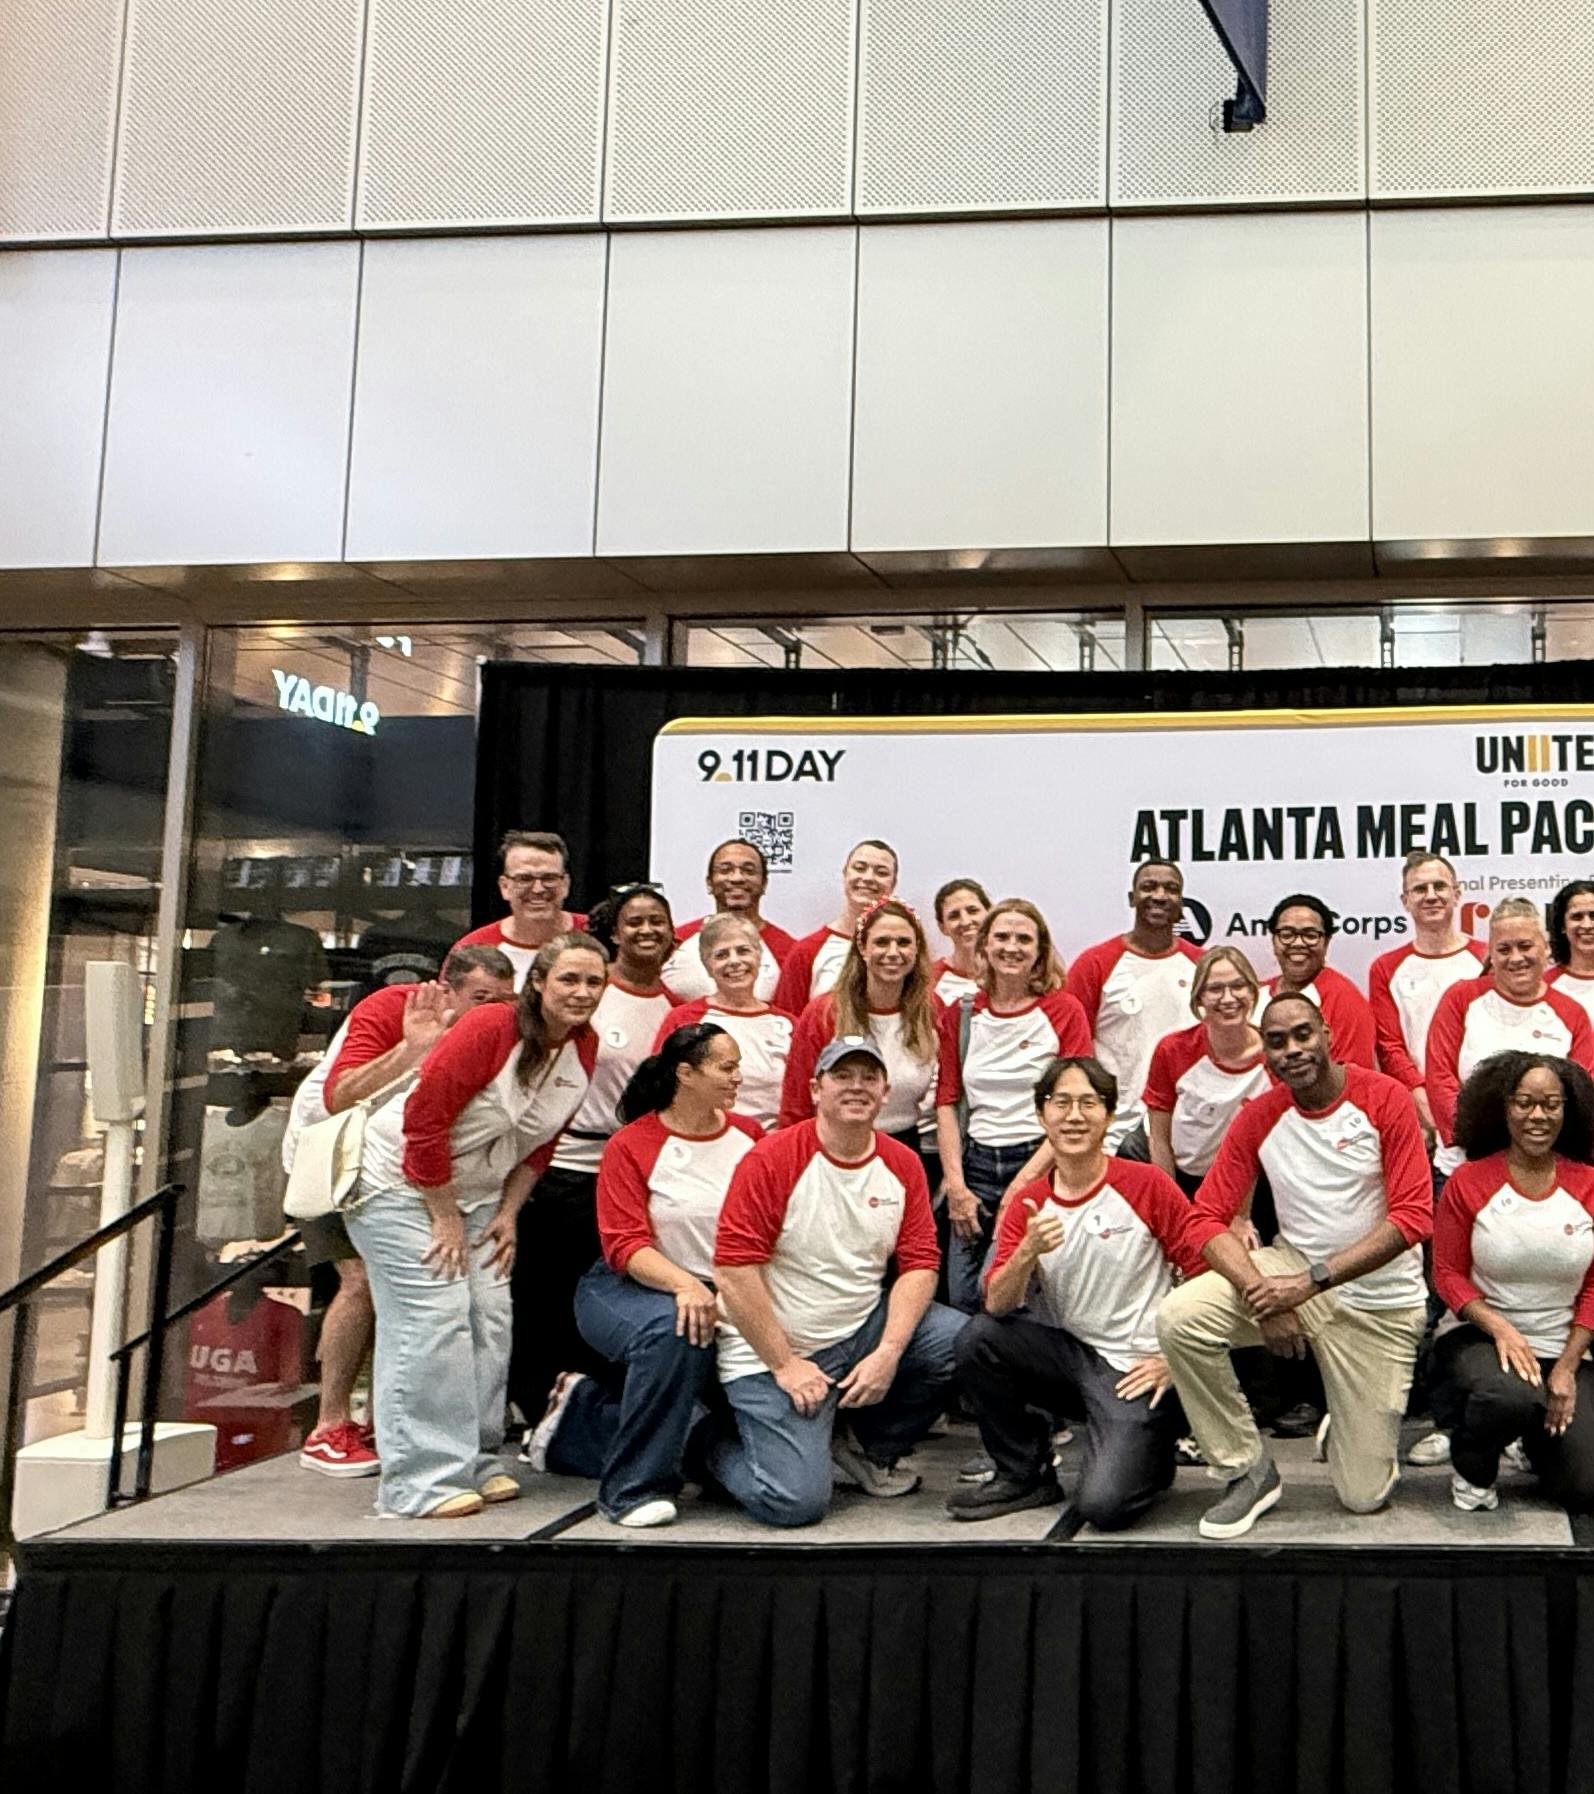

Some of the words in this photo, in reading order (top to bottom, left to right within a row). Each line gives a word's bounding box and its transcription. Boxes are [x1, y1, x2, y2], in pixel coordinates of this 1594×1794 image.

[1504, 779, 1527, 788] FOR
[1532, 778, 1568, 788] GOOD
[1130, 806, 1345, 863] ATLANTA
[1357, 803, 1489, 858] MEAL
[1489, 873, 1578, 891] Presentin
[190, 1345, 258, 1374] UGA
